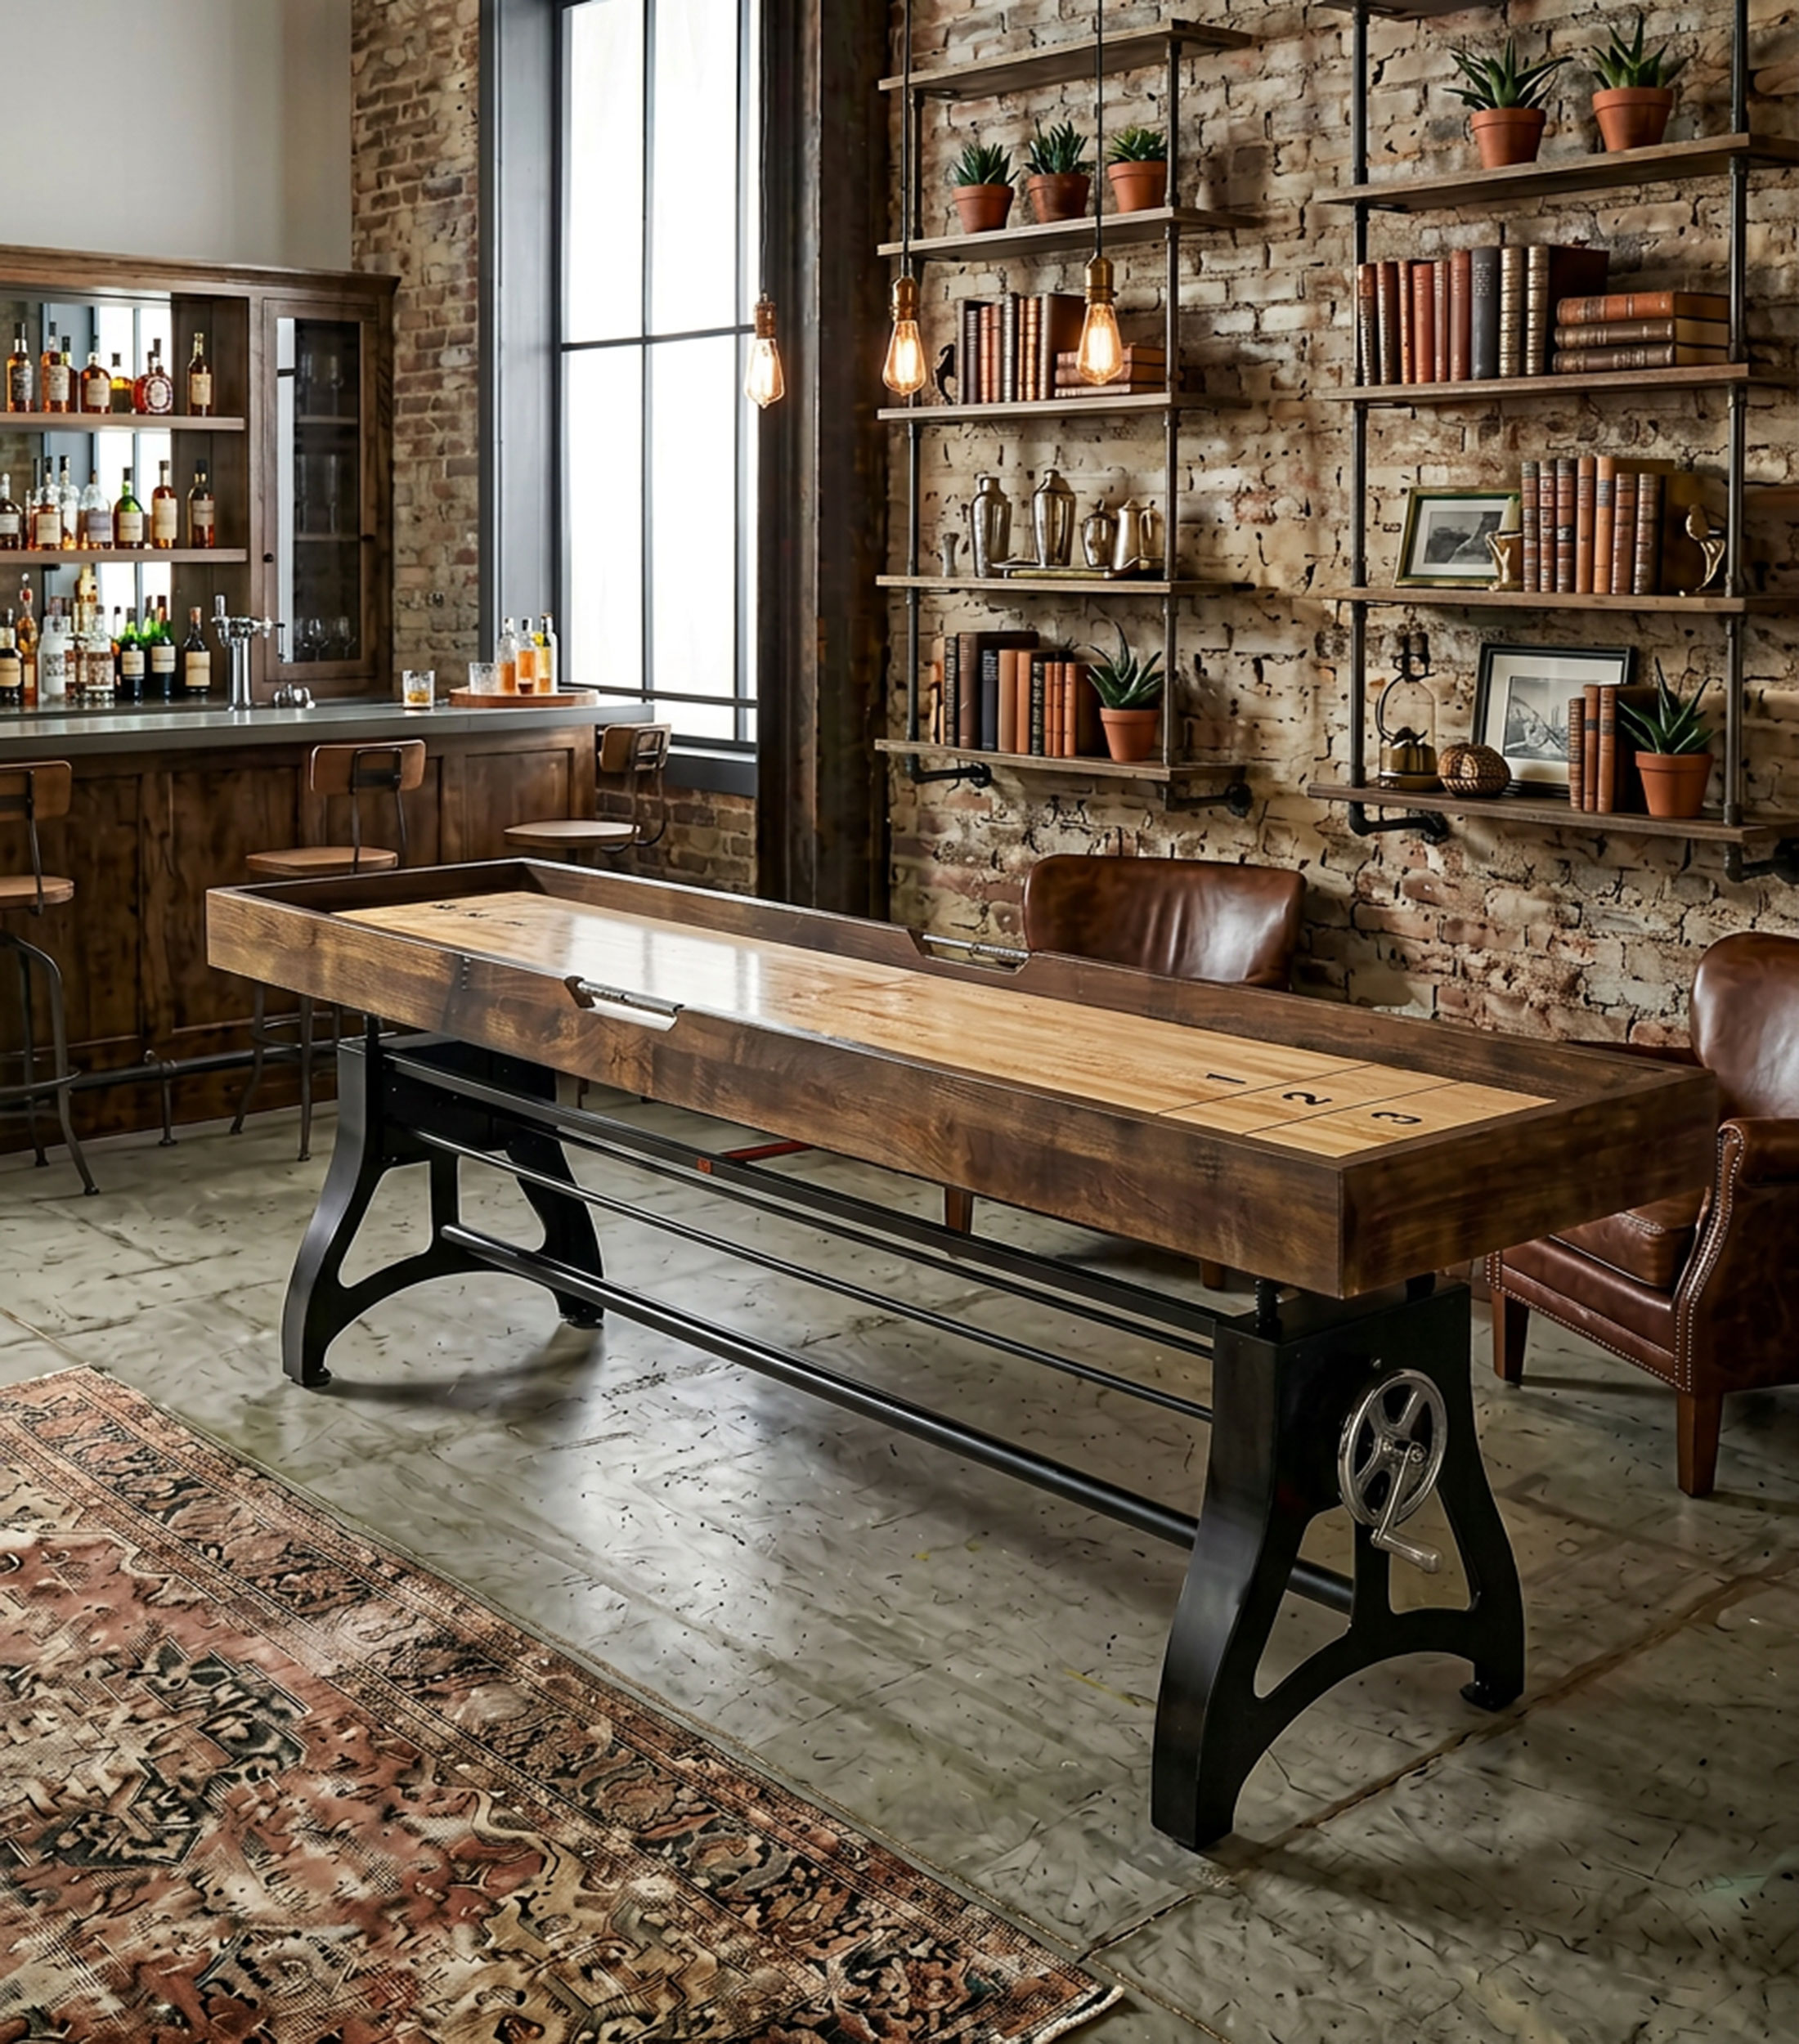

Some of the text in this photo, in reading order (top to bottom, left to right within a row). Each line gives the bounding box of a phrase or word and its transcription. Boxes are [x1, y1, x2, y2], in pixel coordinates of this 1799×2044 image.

[1205, 1073, 1246, 1085] 1
[1282, 1091, 1333, 1106] 2
[1371, 1111, 1423, 1125] 3
